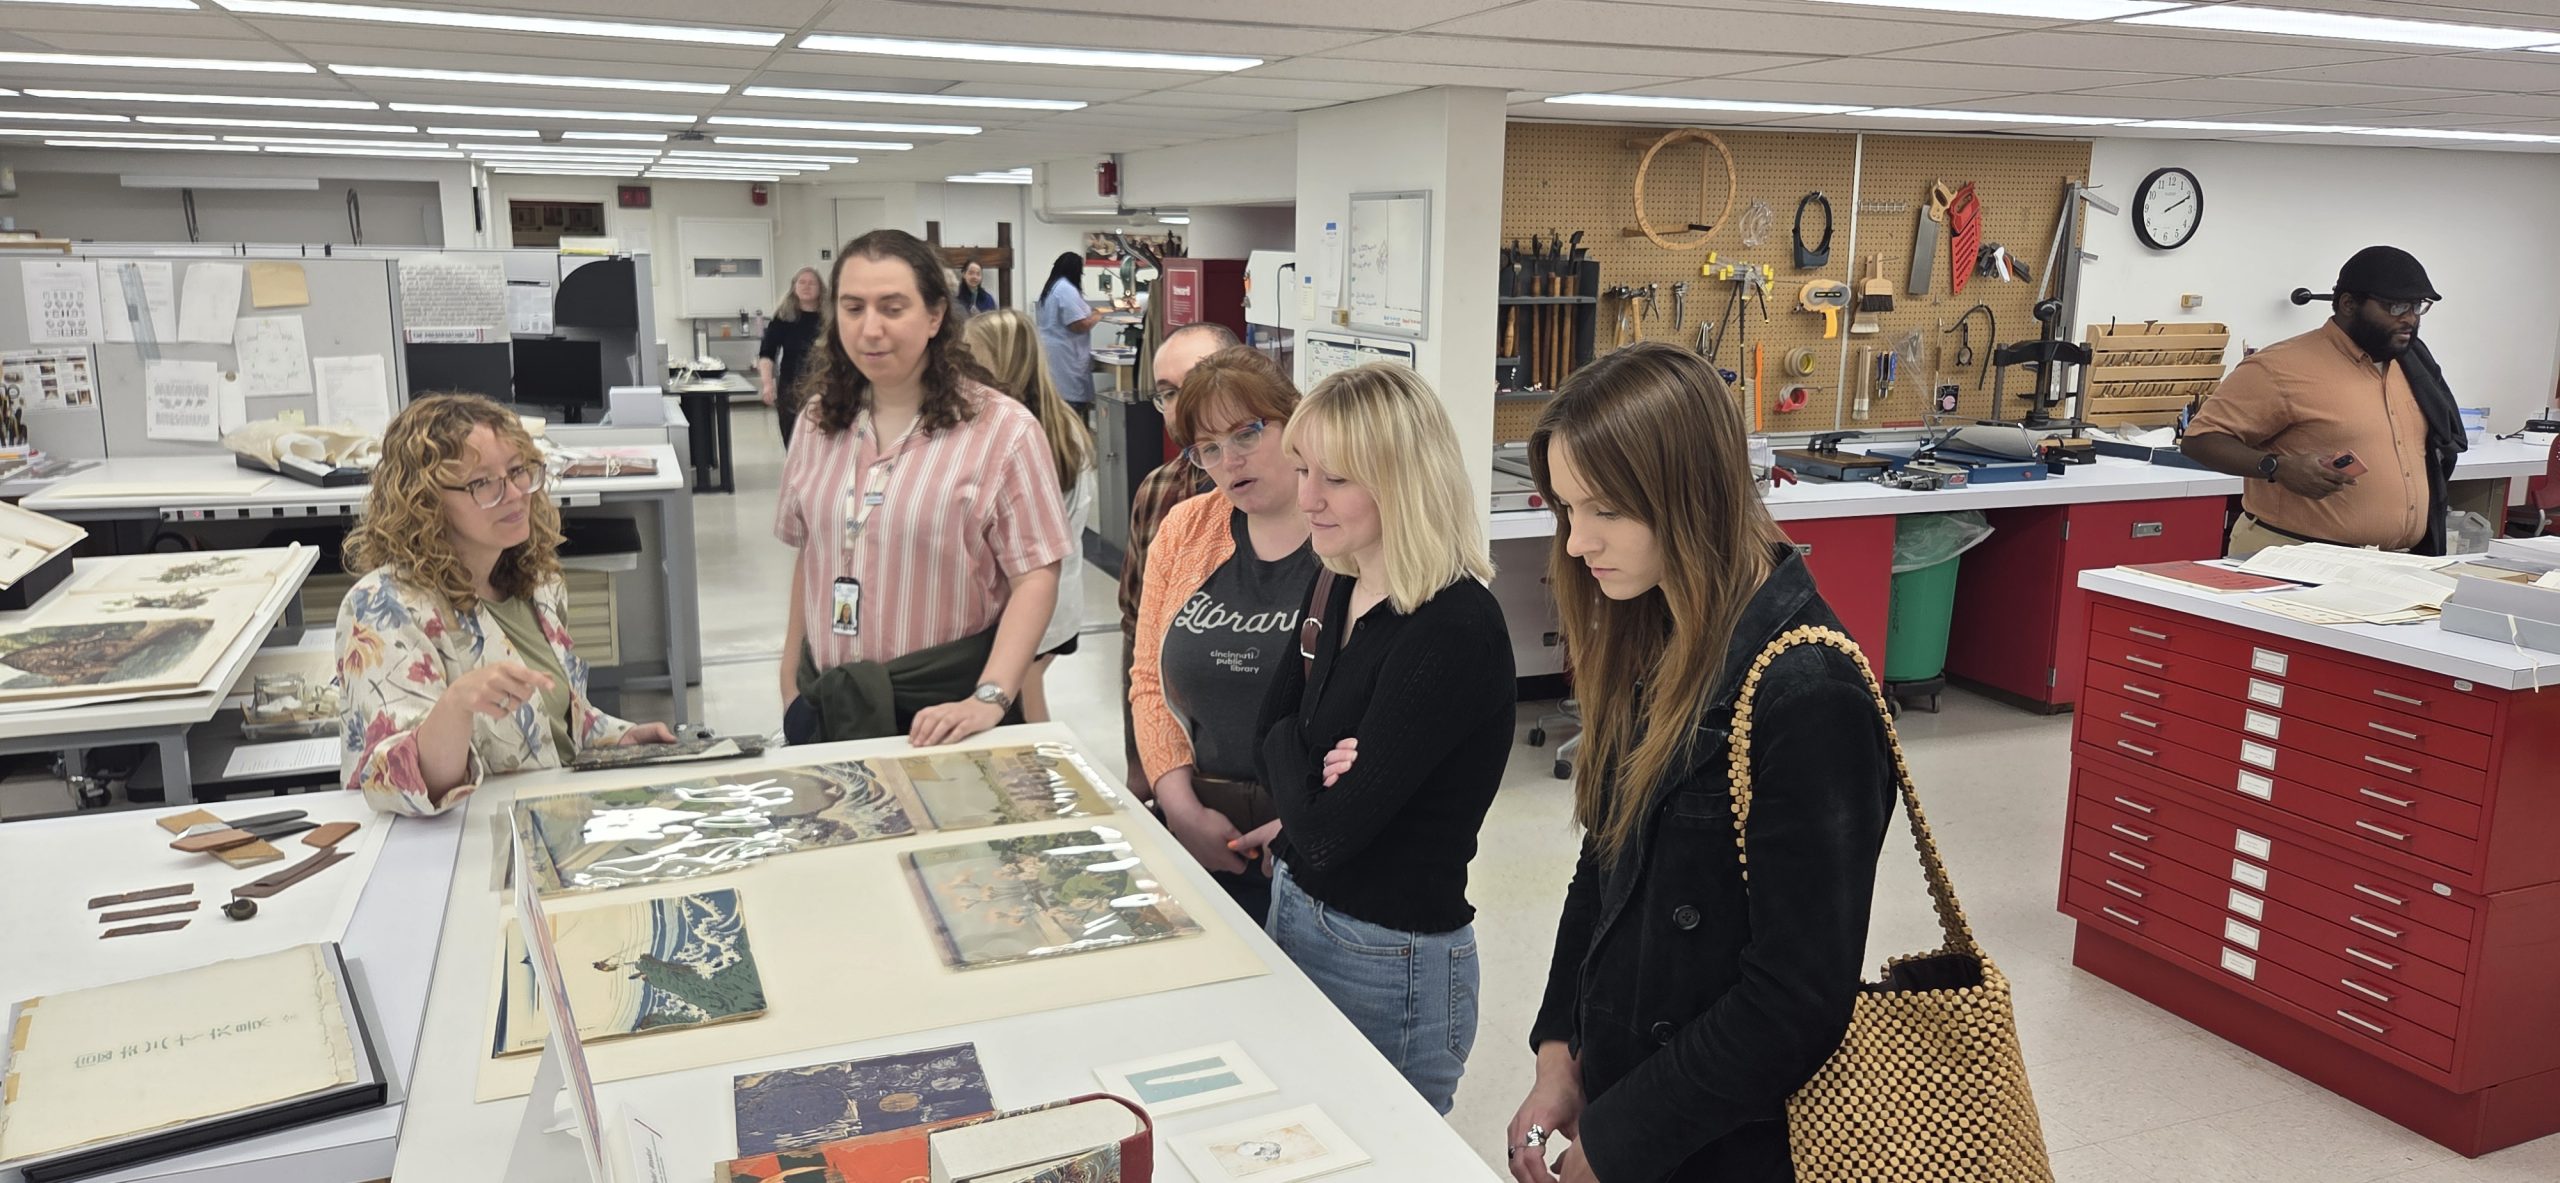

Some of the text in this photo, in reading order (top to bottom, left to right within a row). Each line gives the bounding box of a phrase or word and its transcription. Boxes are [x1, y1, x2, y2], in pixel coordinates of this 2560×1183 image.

[2158, 180, 2164, 189] 11
[2168, 176, 2176, 186] 12
[2180, 181, 2184, 190] 1
[2149, 191, 2156, 200] 10
[2145, 203, 2149, 213] 9
[2188, 205, 2193, 214] 3
[2146, 218, 2151, 227] 8
[2182, 219, 2187, 228] 4
[2153, 228, 2157, 237] 7
[2163, 232, 2168, 241] 6
[2175, 229, 2179, 238] 5
[1210, 649, 1254, 660] cincinnati
[1216, 658, 1243, 666] public
[1230, 665, 1260, 674] library
